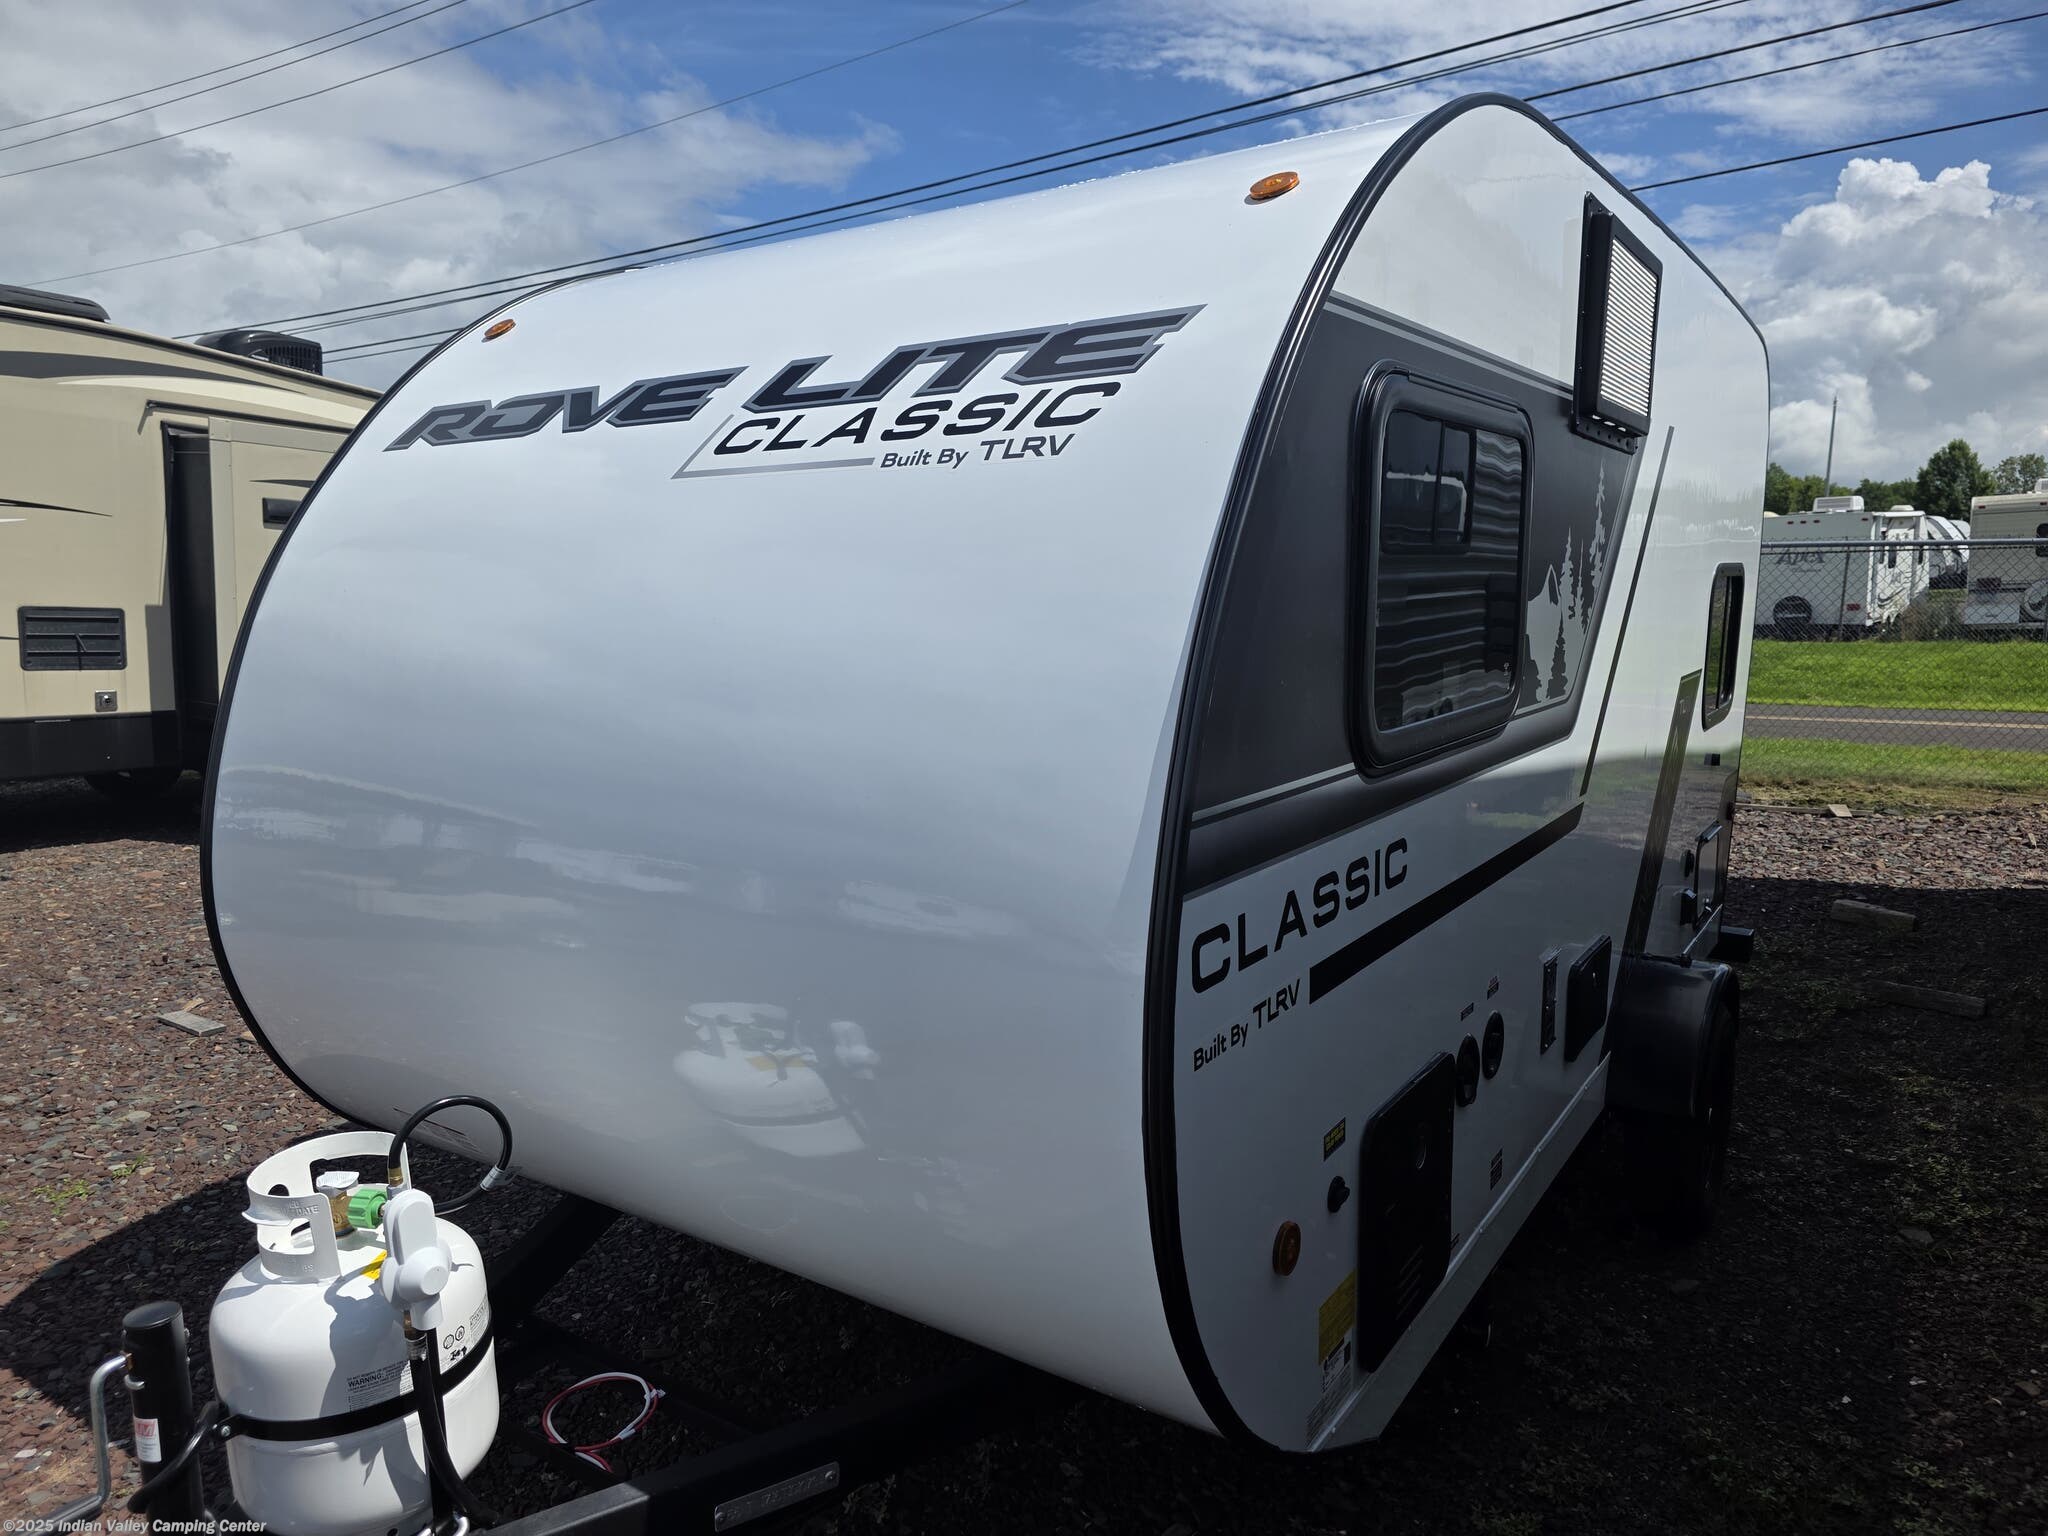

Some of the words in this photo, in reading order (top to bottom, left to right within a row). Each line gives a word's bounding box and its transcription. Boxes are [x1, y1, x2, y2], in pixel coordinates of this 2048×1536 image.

[382, 366, 749, 452] ROVE
[741, 304, 1208, 413] LITE
[713, 382, 1121, 455] CLASSIC
[880, 449, 930, 468] Built
[937, 448, 969, 469] By
[980, 433, 1075, 461] TLRV
[1191, 837, 1407, 993] CLASSIC
[1193, 1033, 1227, 1072] Built
[1230, 1023, 1248, 1047] By
[1252, 978, 1300, 1029] TLRV
